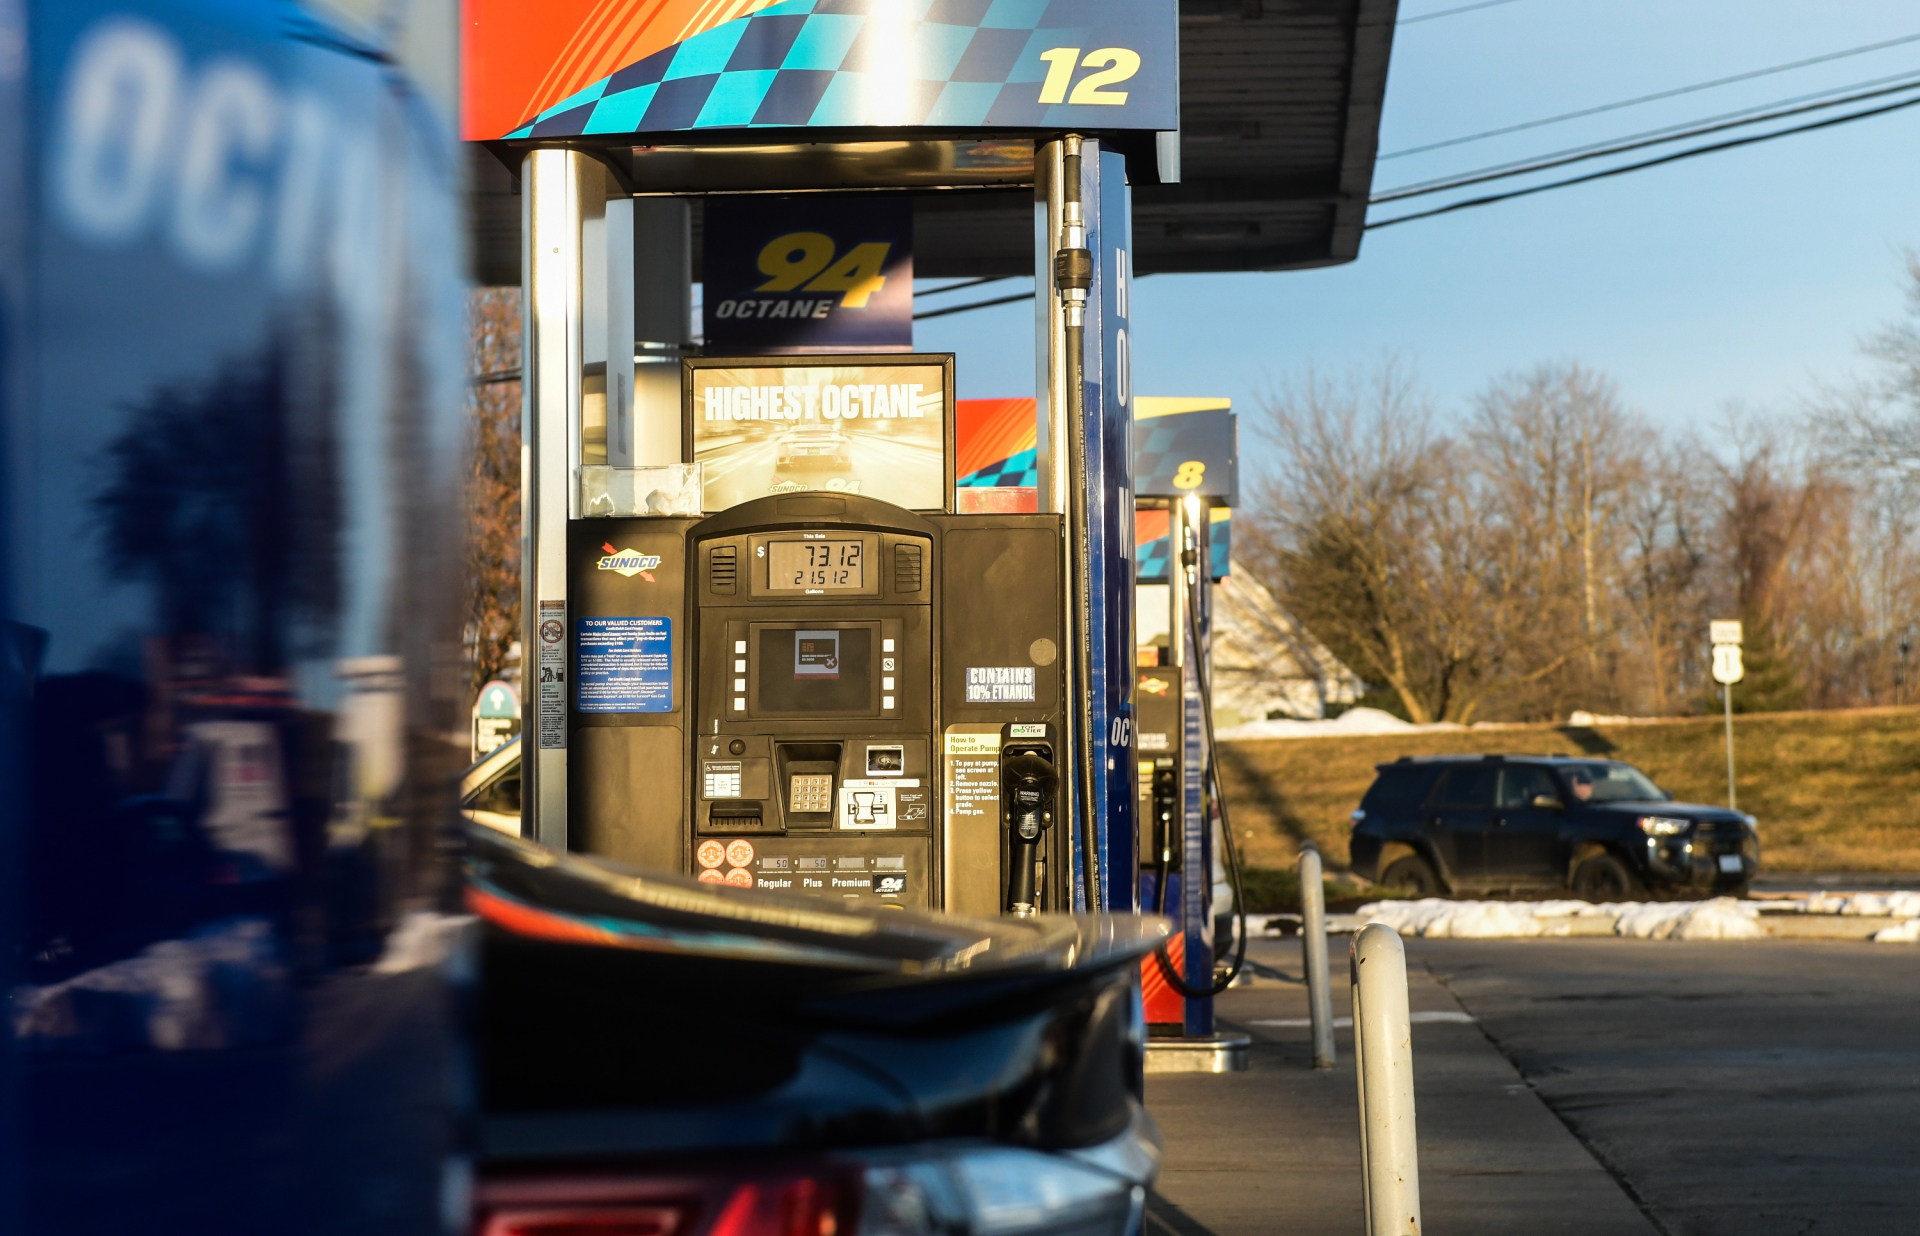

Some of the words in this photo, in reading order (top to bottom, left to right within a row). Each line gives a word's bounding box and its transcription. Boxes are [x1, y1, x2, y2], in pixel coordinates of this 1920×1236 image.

[1038, 47, 1141, 106] 12
[752, 231, 892, 308] 94
[715, 299, 833, 319] OCTANE
[705, 385, 819, 421] HIGHEST
[822, 383, 924, 420] OCTANE
[1173, 460, 1206, 490] 8
[771, 485, 807, 493] SUNOCO
[825, 477, 861, 494] 94
[600, 557, 659, 569] SUNOCO
[757, 546, 765, 558] $
[805, 545, 860, 567] 73.12
[794, 571, 848, 585] 21.512
[970, 667, 1032, 684] CONTAINS
[968, 684, 991, 700] 10%
[992, 684, 1034, 700] ETHANOL
[950, 745, 979, 753] Operate
[980, 745, 1000, 753] Pump
[757, 878, 792, 890] Regular
[803, 878, 823, 888] Plus
[832, 877, 871, 888] Premium
[880, 877, 904, 891] 94
